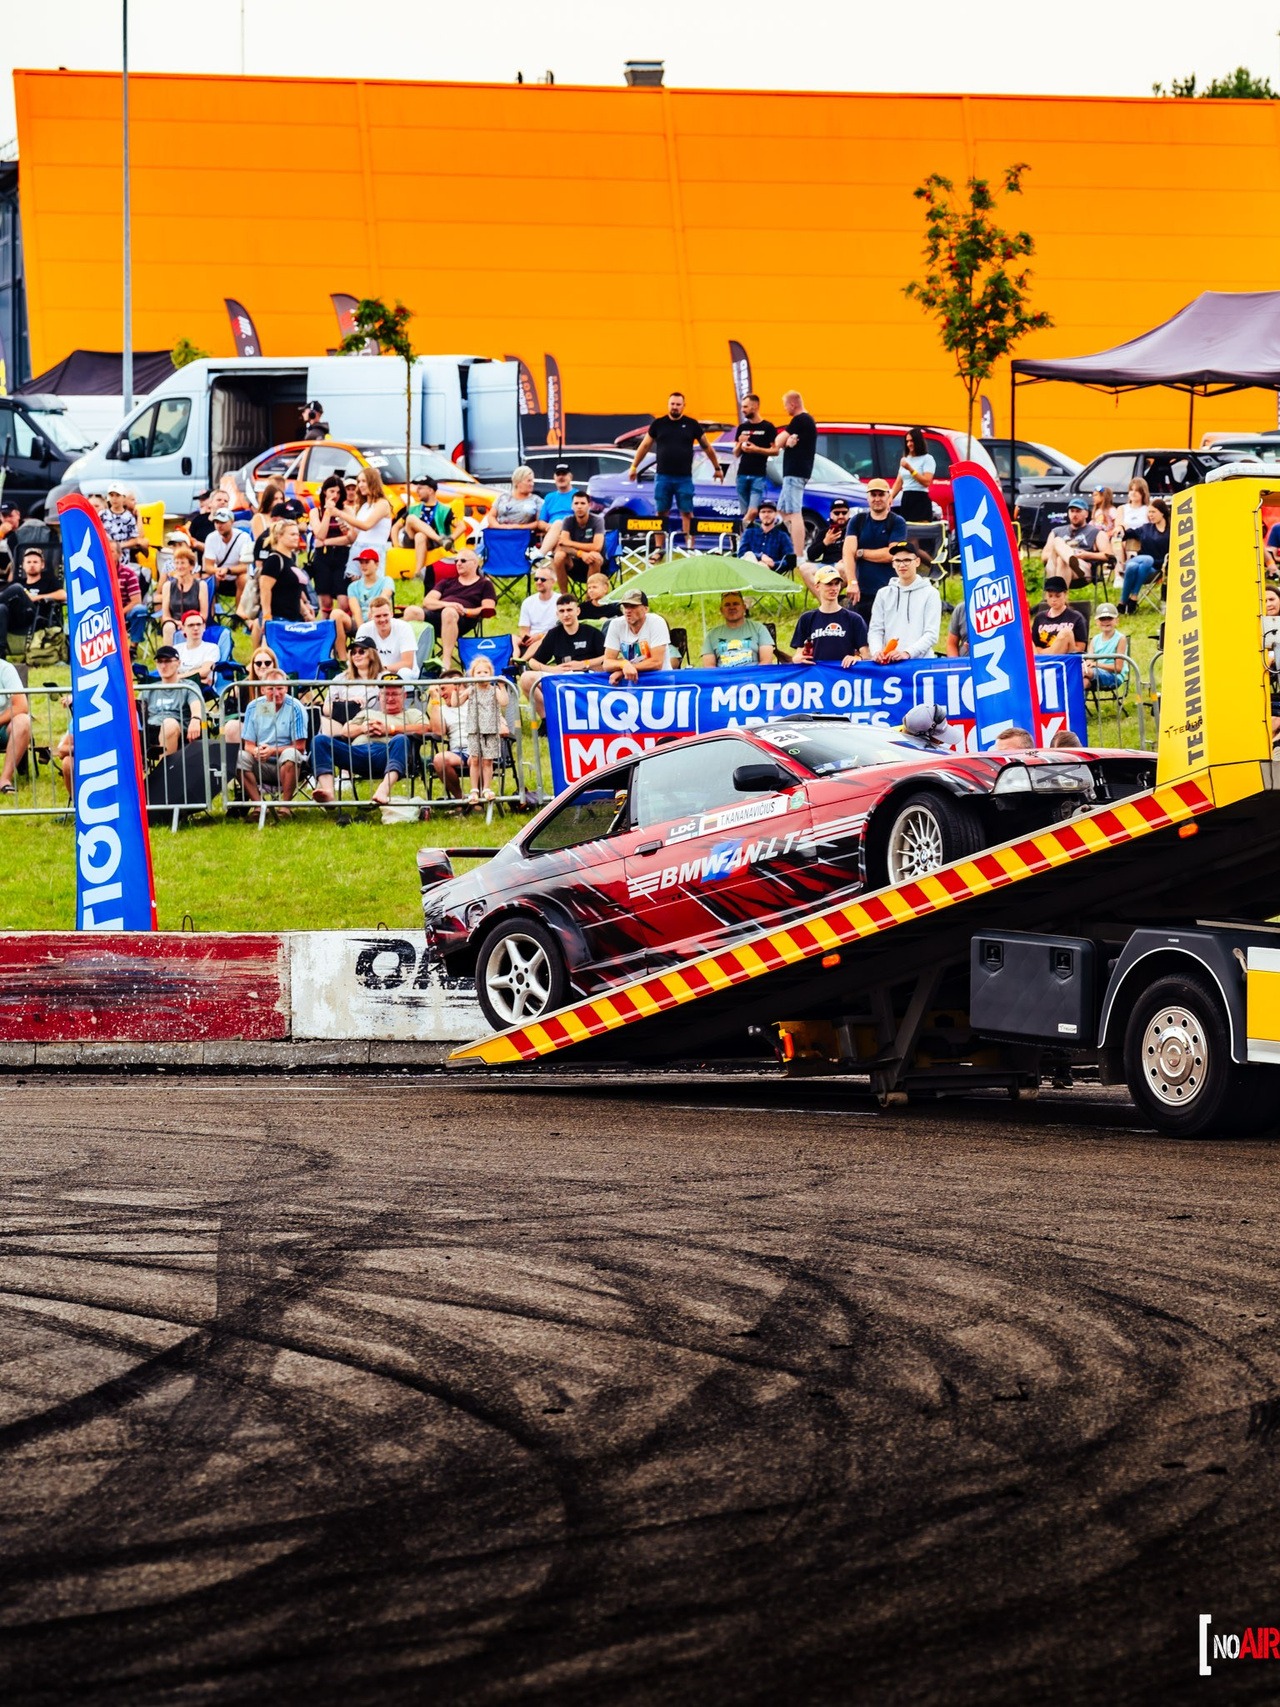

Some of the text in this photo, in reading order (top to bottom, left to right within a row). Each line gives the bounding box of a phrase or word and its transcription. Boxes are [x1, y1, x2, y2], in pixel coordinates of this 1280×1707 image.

[1176, 496, 1198, 622] PAGALBA
[564, 690, 691, 733] LIQUI
[711, 676, 902, 712] MOTOR OILS
[1178, 628, 1205, 766] TECHNINĖ
